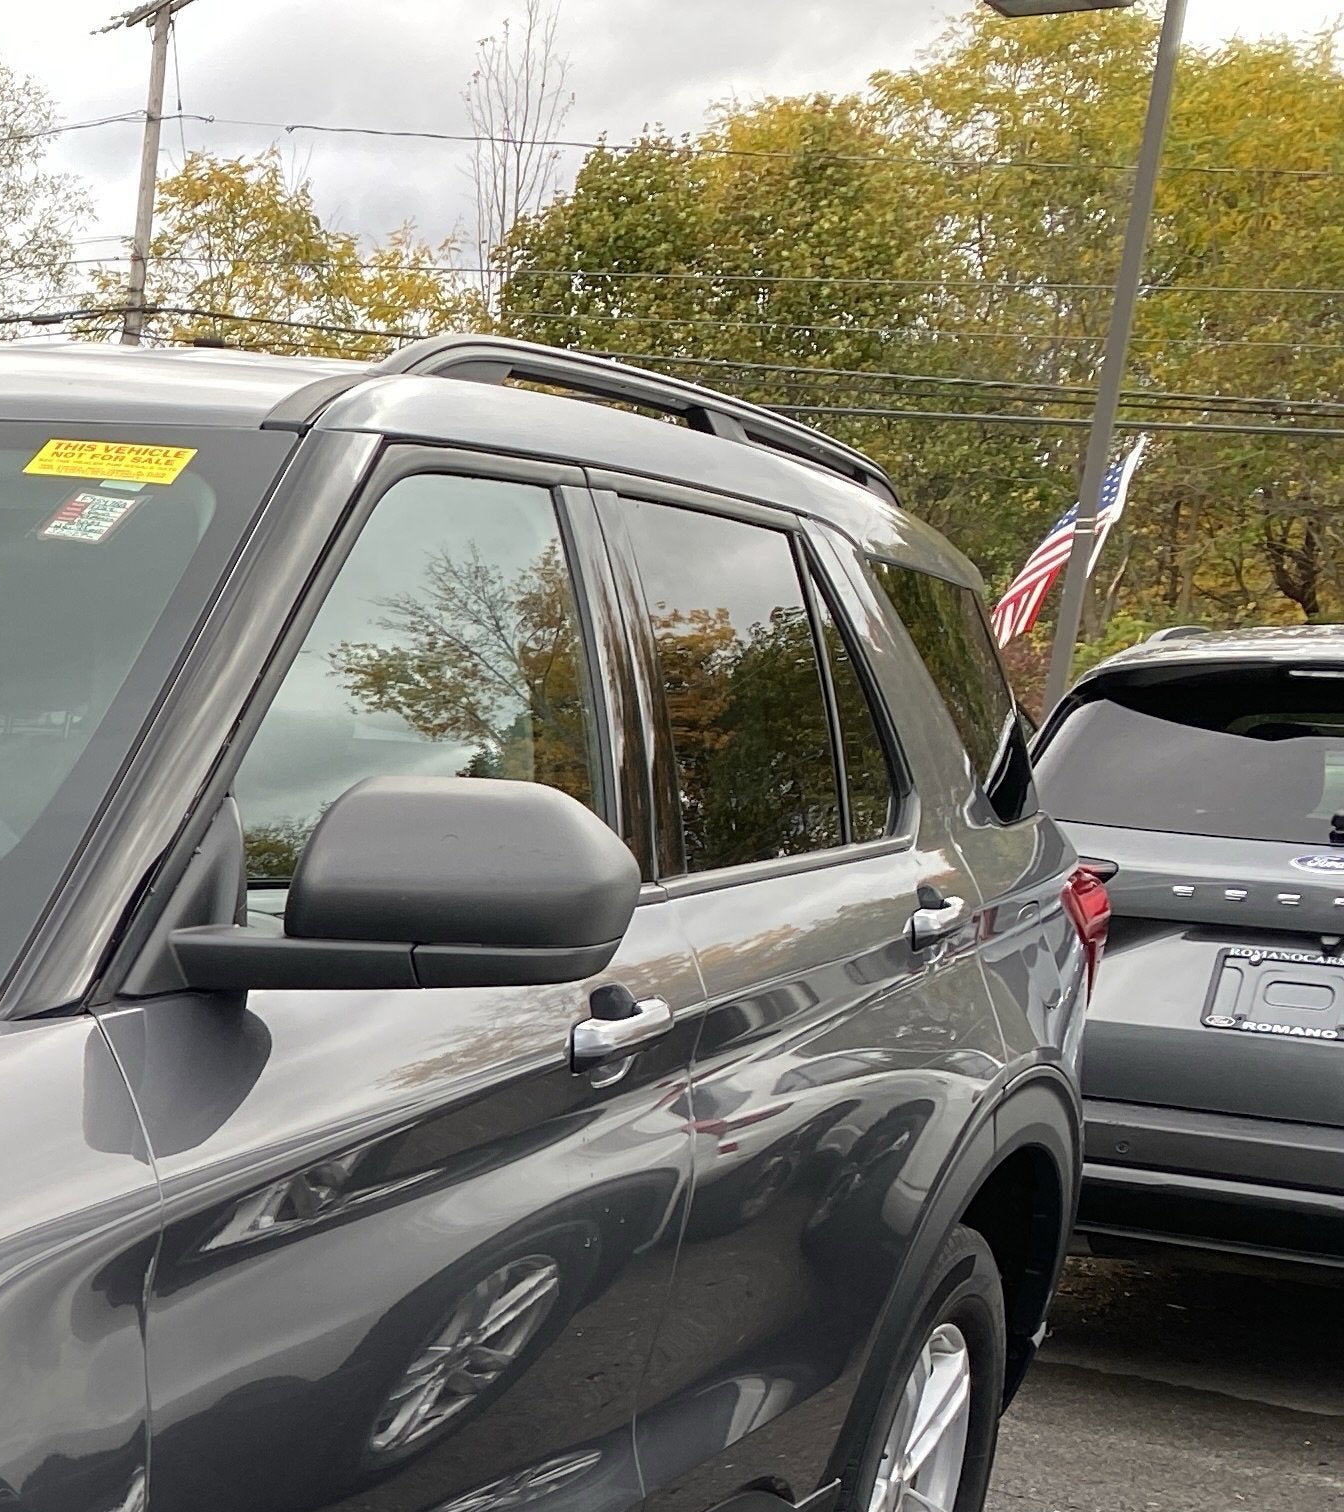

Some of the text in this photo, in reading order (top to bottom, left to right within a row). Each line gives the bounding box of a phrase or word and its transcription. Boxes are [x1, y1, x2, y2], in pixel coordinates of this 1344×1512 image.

[50, 451, 87, 459] NOT
[90, 453, 126, 462] FOR
[130, 456, 177, 466] SALE
[53, 442, 188, 459] THIS VEHICLE
[1242, 1021, 1338, 1039] ROMANO
